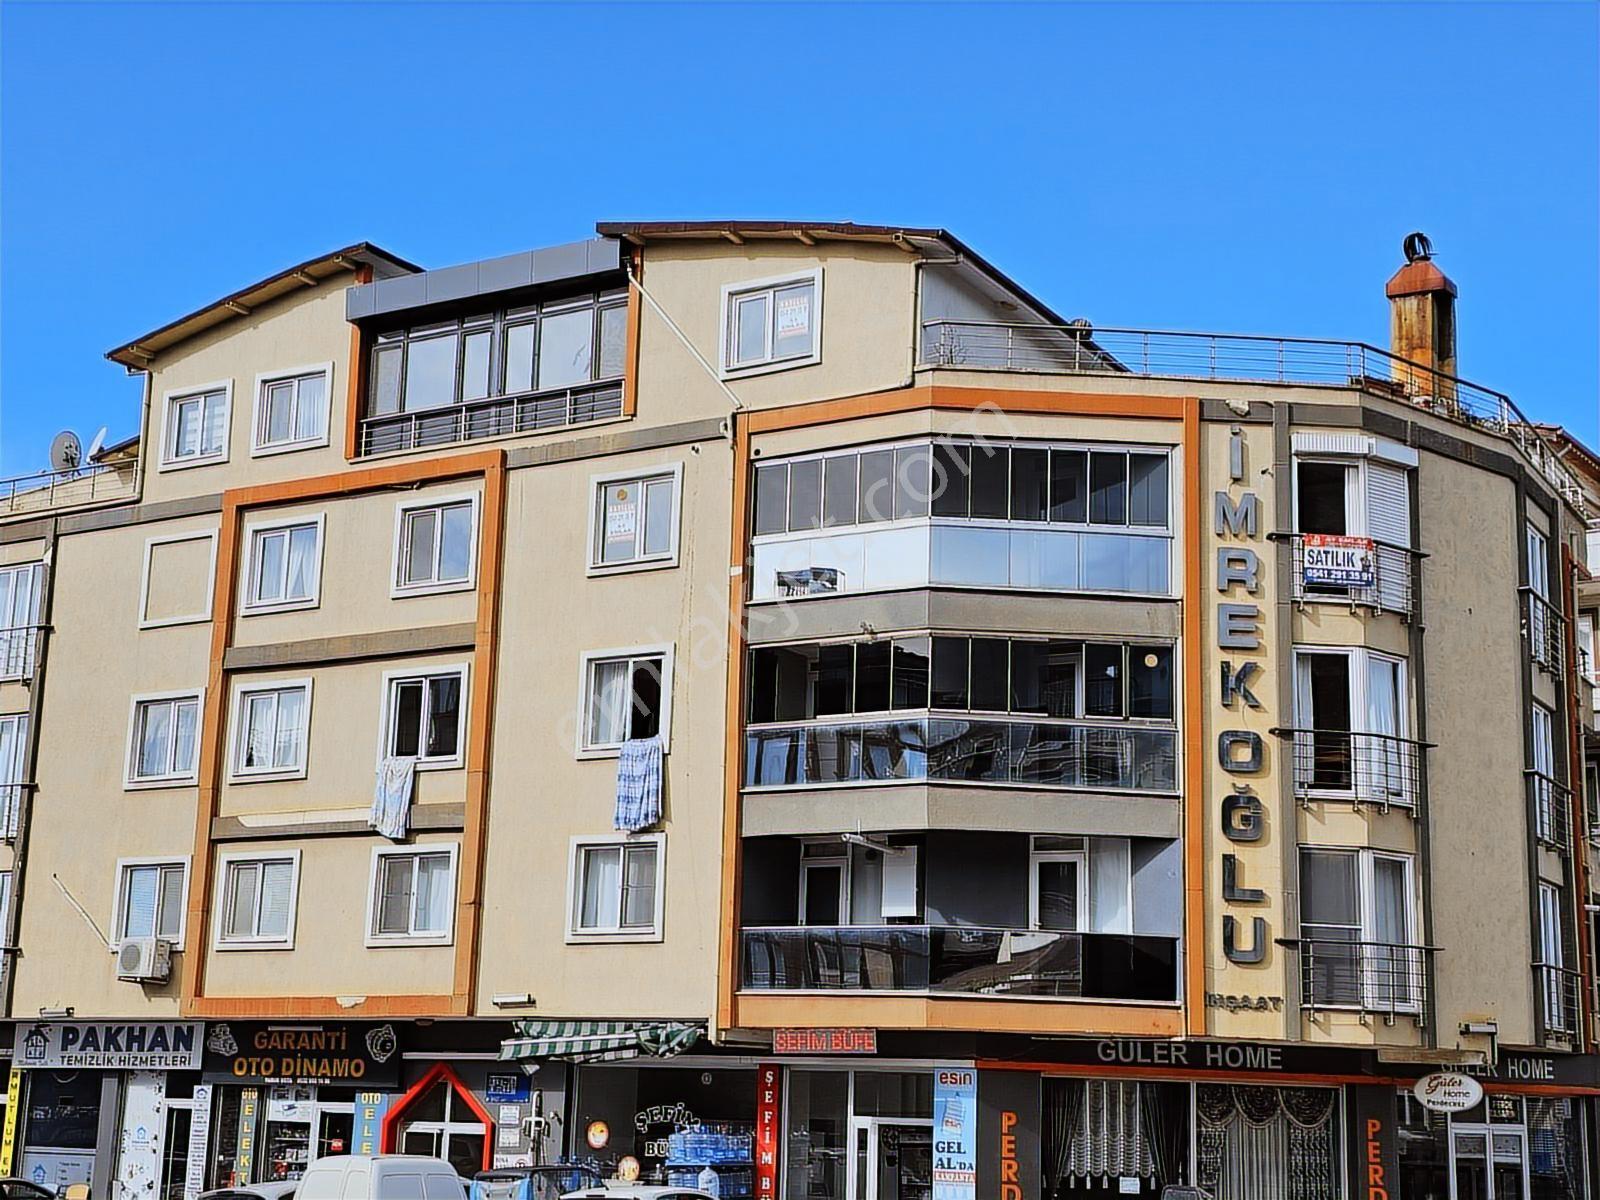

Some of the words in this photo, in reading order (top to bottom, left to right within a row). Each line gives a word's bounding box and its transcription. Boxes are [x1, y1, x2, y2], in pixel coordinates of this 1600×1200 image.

[1307, 549, 1356, 568] SATILIK
[1214, 424, 1266, 964] İMREKOĞLU
[61, 1026, 195, 1052] PAKHAN
[254, 1026, 347, 1050] GARANTİ
[60, 1053, 115, 1067] TEMİZLİK
[118, 1053, 192, 1067] HİZMETLERİ
[233, 1057, 275, 1077] OTO
[281, 1053, 366, 1078] DİNAMO
[1206, 1044, 1282, 1070] HOME
[1508, 1057, 1555, 1080] HOME
[939, 1072, 973, 1085] esin
[361, 1092, 382, 1105] OTO
[1443, 1090, 1471, 1098] Home
[760, 1071, 774, 1165] ŞEFİM
[361, 1108, 376, 1154] ELE
[239, 1104, 255, 1184] ELEKT
[935, 1141, 967, 1155] GEL
